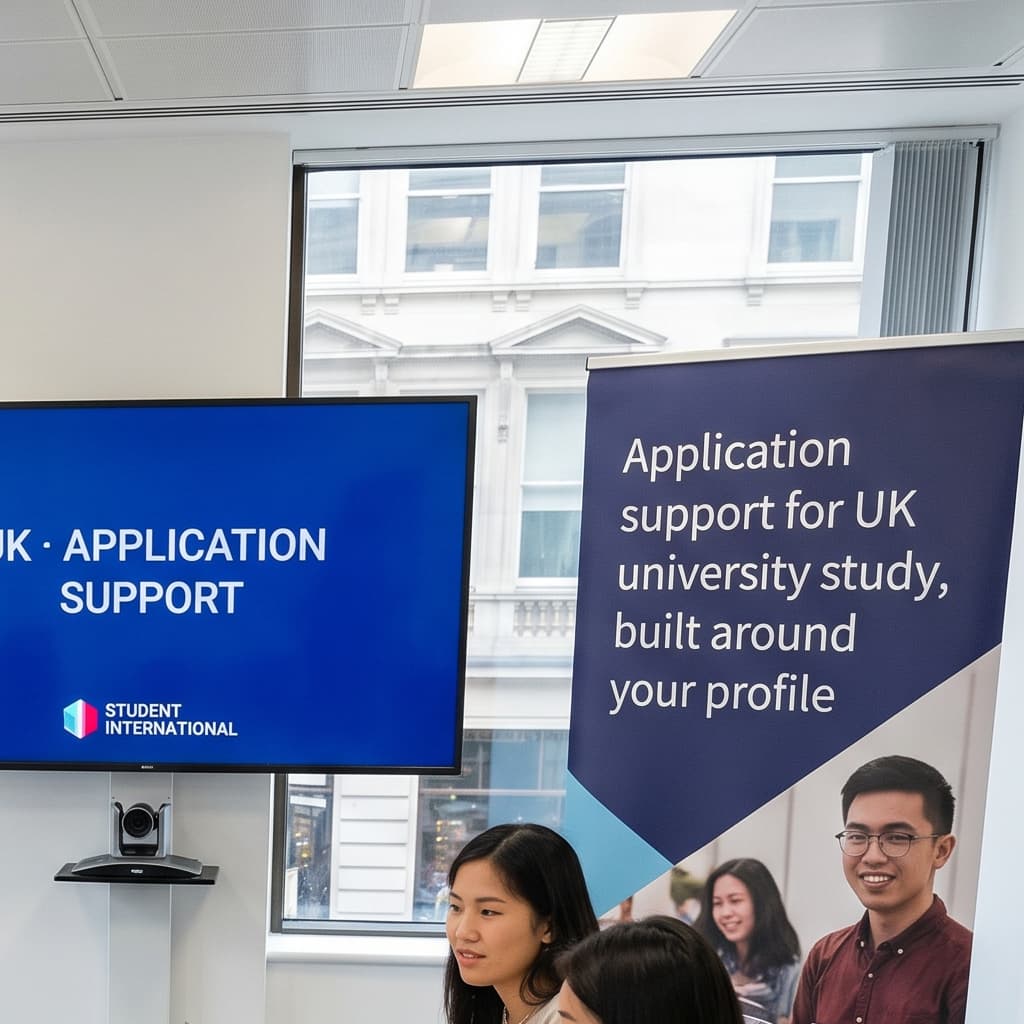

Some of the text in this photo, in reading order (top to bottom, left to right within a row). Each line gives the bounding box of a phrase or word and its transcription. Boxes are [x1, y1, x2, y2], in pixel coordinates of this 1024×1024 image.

[622, 429, 852, 483] Application
[619, 489, 918, 542] support for UK
[62, 527, 327, 563] APPLICATION
[59, 580, 245, 615] SUPPORT
[617, 549, 950, 603] university study,
[613, 611, 858, 654] built around
[104, 702, 183, 719] STUDENT
[607, 673, 836, 720] your profile
[104, 720, 239, 737] INTERNATIONAL
